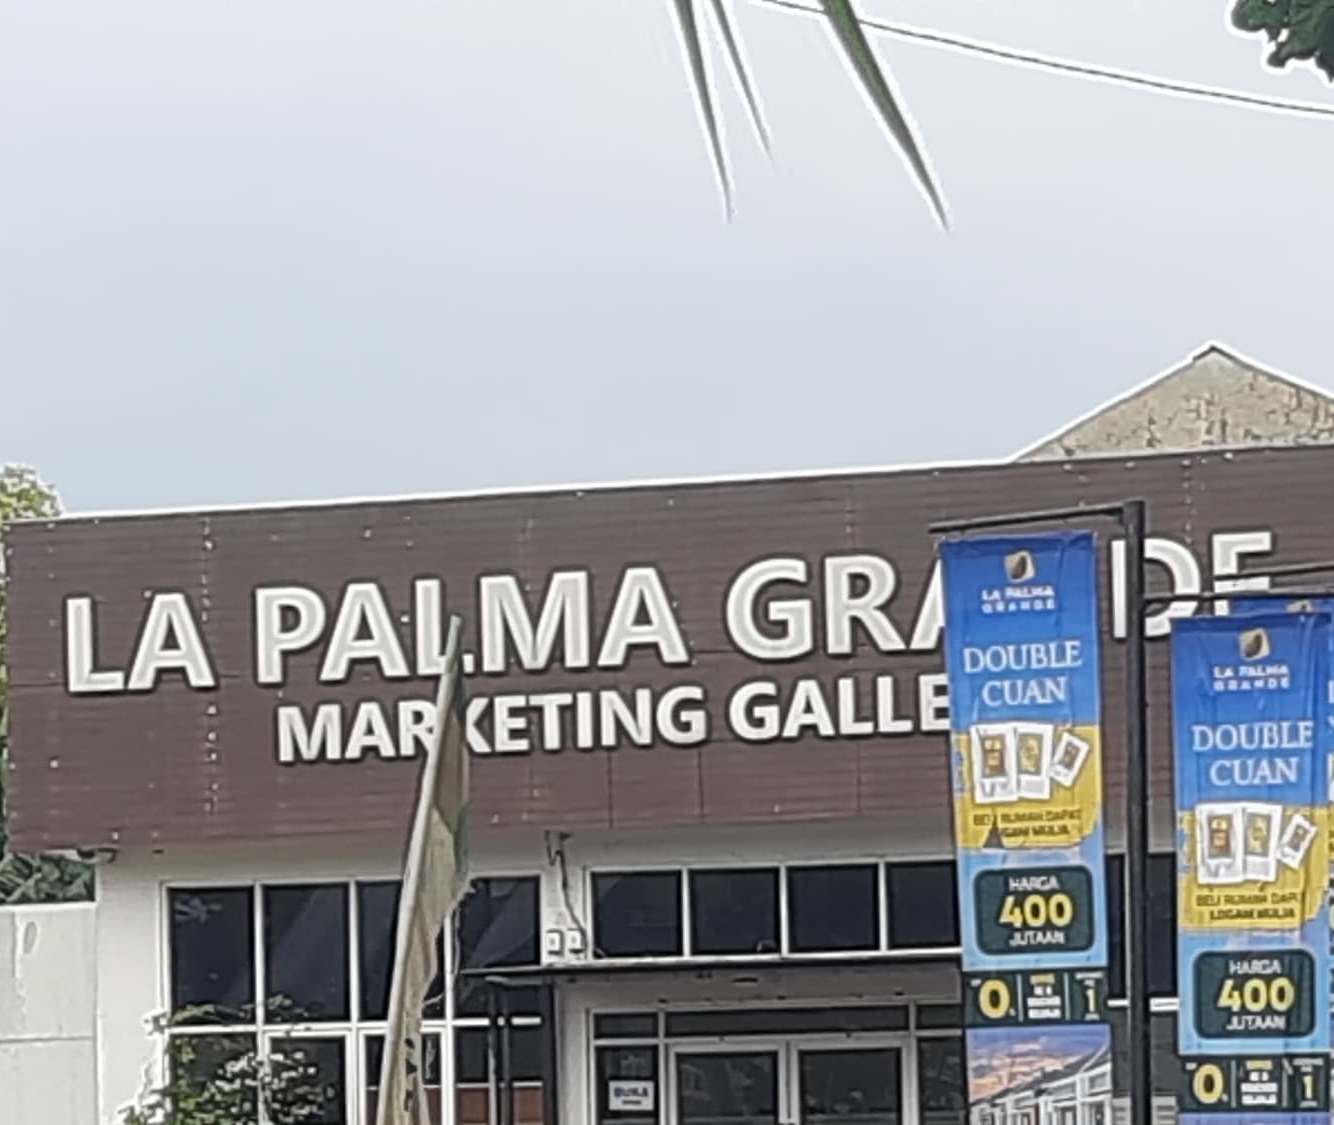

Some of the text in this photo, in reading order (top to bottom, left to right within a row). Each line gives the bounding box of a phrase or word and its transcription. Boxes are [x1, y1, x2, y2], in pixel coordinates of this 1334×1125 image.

[66, 592, 216, 693] LA
[254, 566, 690, 684] PALMA
[963, 640, 1082, 674] DOUBLE
[982, 677, 1067, 706] CUAN
[276, 684, 708, 763] MARKETING
[1192, 720, 1314, 751] DOUBLE
[1209, 756, 1301, 787] CUAN
[1008, 875, 1061, 892] HARGA
[998, 892, 1074, 929] 400
[1008, 929, 1066, 947] JUTAAN
[1228, 959, 1282, 975] HARGA
[1216, 976, 1295, 1013] 400
[1226, 1014, 1287, 1031] JUTAAN
